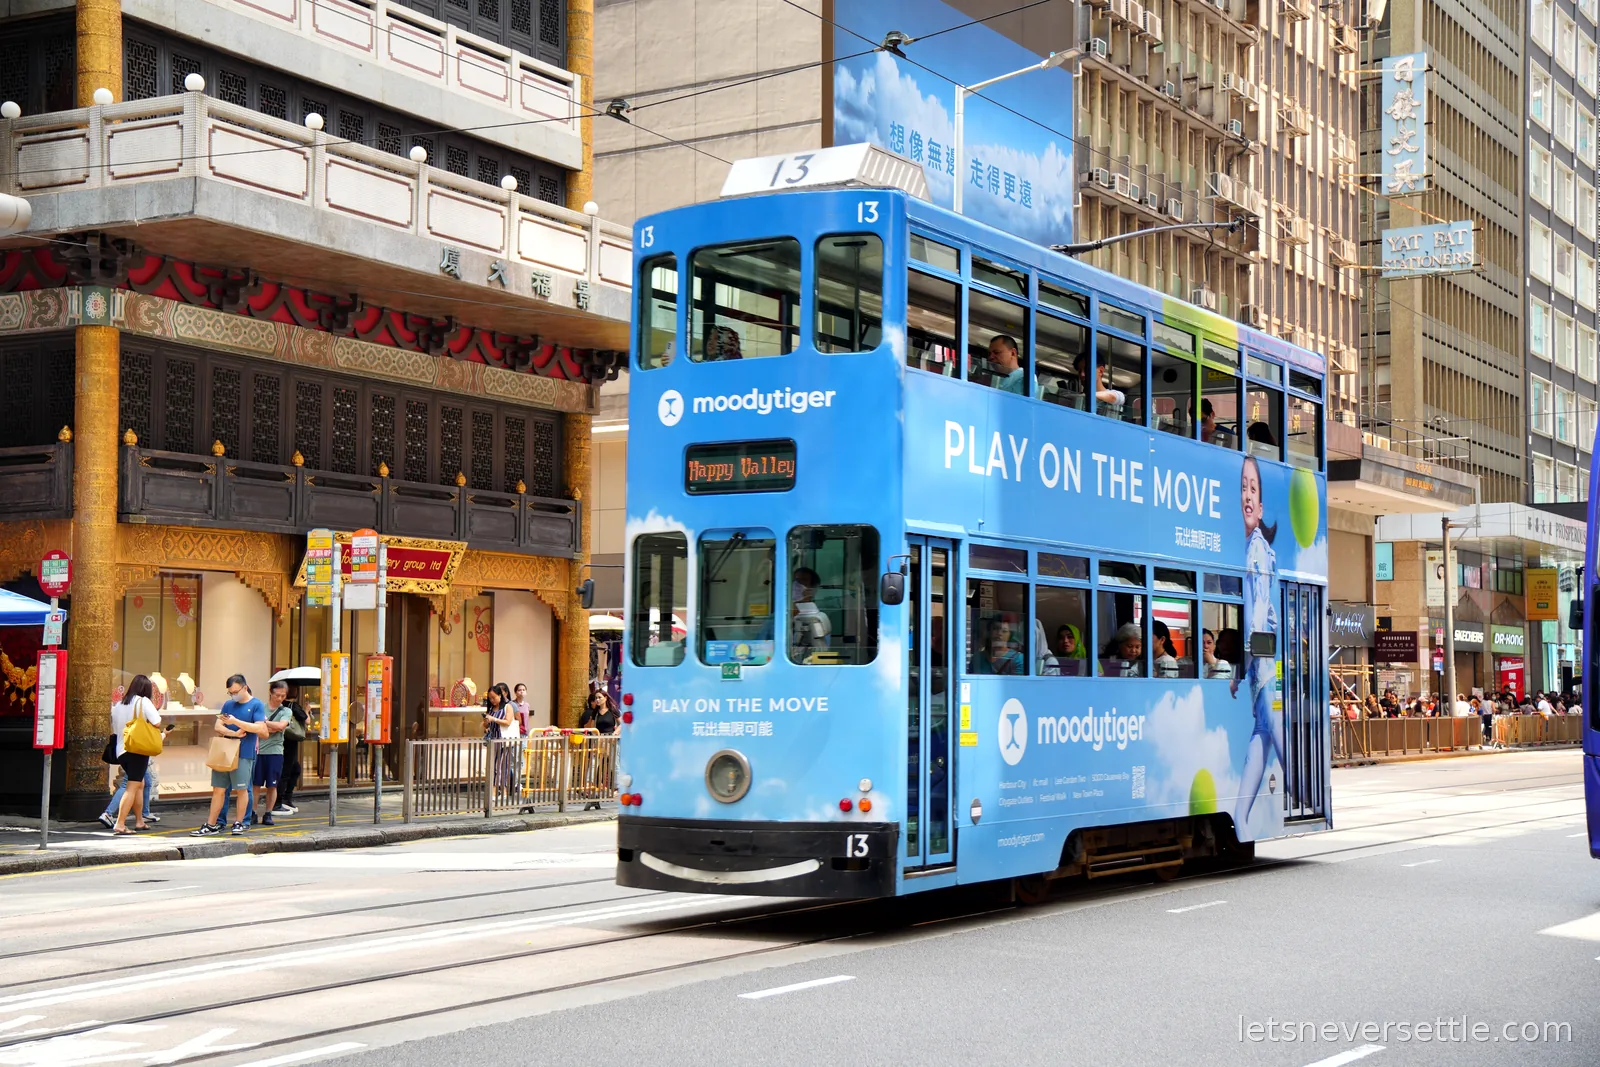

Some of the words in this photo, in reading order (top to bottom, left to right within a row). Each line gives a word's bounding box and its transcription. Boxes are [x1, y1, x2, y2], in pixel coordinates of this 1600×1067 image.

[769, 153, 816, 187] 13
[970, 157, 1032, 209] 走得更遠
[857, 201, 880, 223] 13
[640, 225, 655, 249] 13
[1386, 234, 1424, 253] YAT
[1383, 251, 1472, 272] STATIONERS
[692, 387, 837, 415] moodytiger
[688, 460, 734, 482] Happy
[740, 456, 795, 479] Valley
[944, 419, 1029, 483] PLAY
[1039, 442, 1081, 494] ON
[1092, 452, 1144, 505] THE
[1153, 465, 1221, 520] MOVE
[1174, 525, 1221, 553] 玩出無限可能
[403, 559, 426, 571] group
[430, 561, 442, 570] ltd
[1453, 629, 1484, 644] SKECHERS
[652, 699, 690, 713] PLAY
[695, 699, 720, 713] ON
[726, 698, 762, 713] THE
[769, 697, 829, 712] MOVE
[692, 721, 773, 737] 玩出無限可能
[1037, 706, 1145, 752] moodytiger
[847, 834, 869, 858] 13
[998, 832, 1045, 848] moodytiger.com
